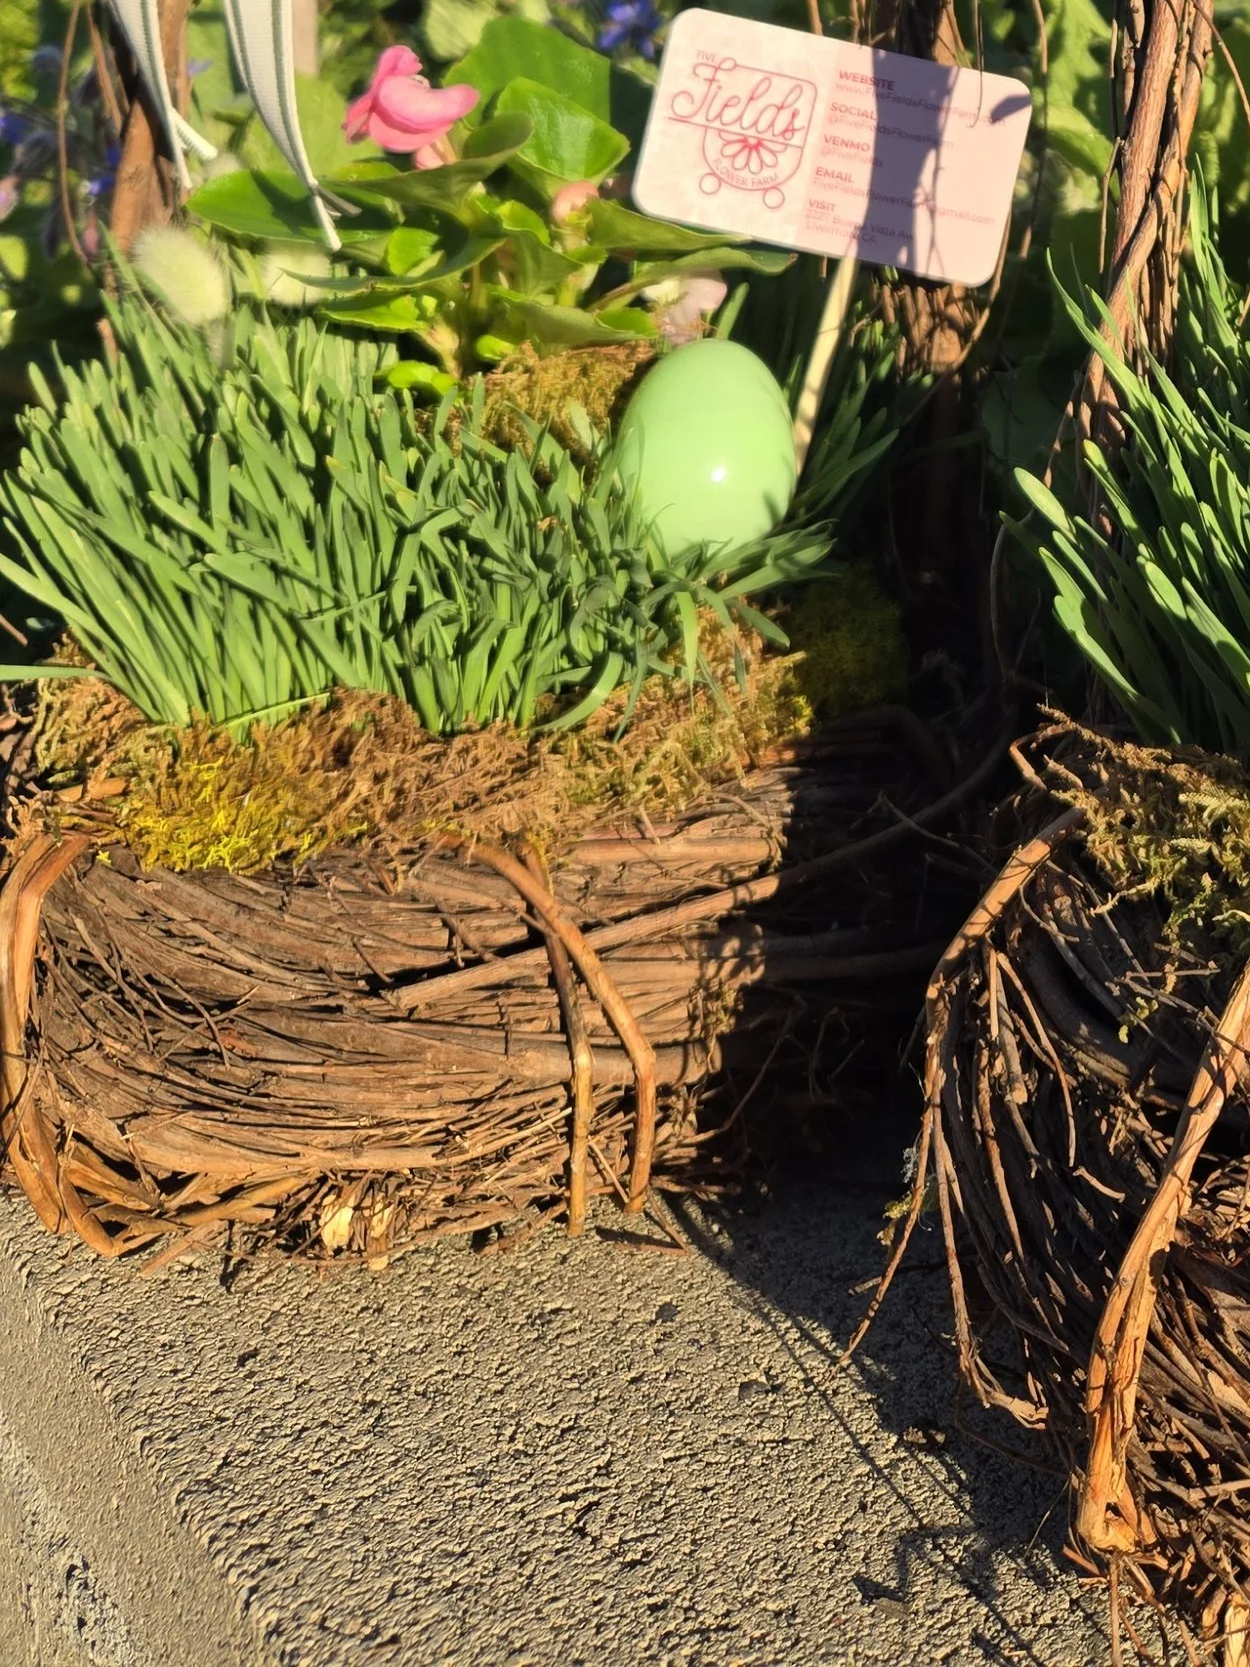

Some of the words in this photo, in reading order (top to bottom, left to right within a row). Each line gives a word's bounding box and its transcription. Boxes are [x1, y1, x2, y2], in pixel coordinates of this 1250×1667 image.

[696, 50, 718, 63] FIVE
[839, 70, 896, 91] WEBSITE
[671, 57, 806, 141] Fields
[830, 102, 877, 120] SOCIAL
[823, 135, 870, 152] VENMO
[815, 166, 855, 183] EMAIL
[808, 197, 837, 212] VISIT
